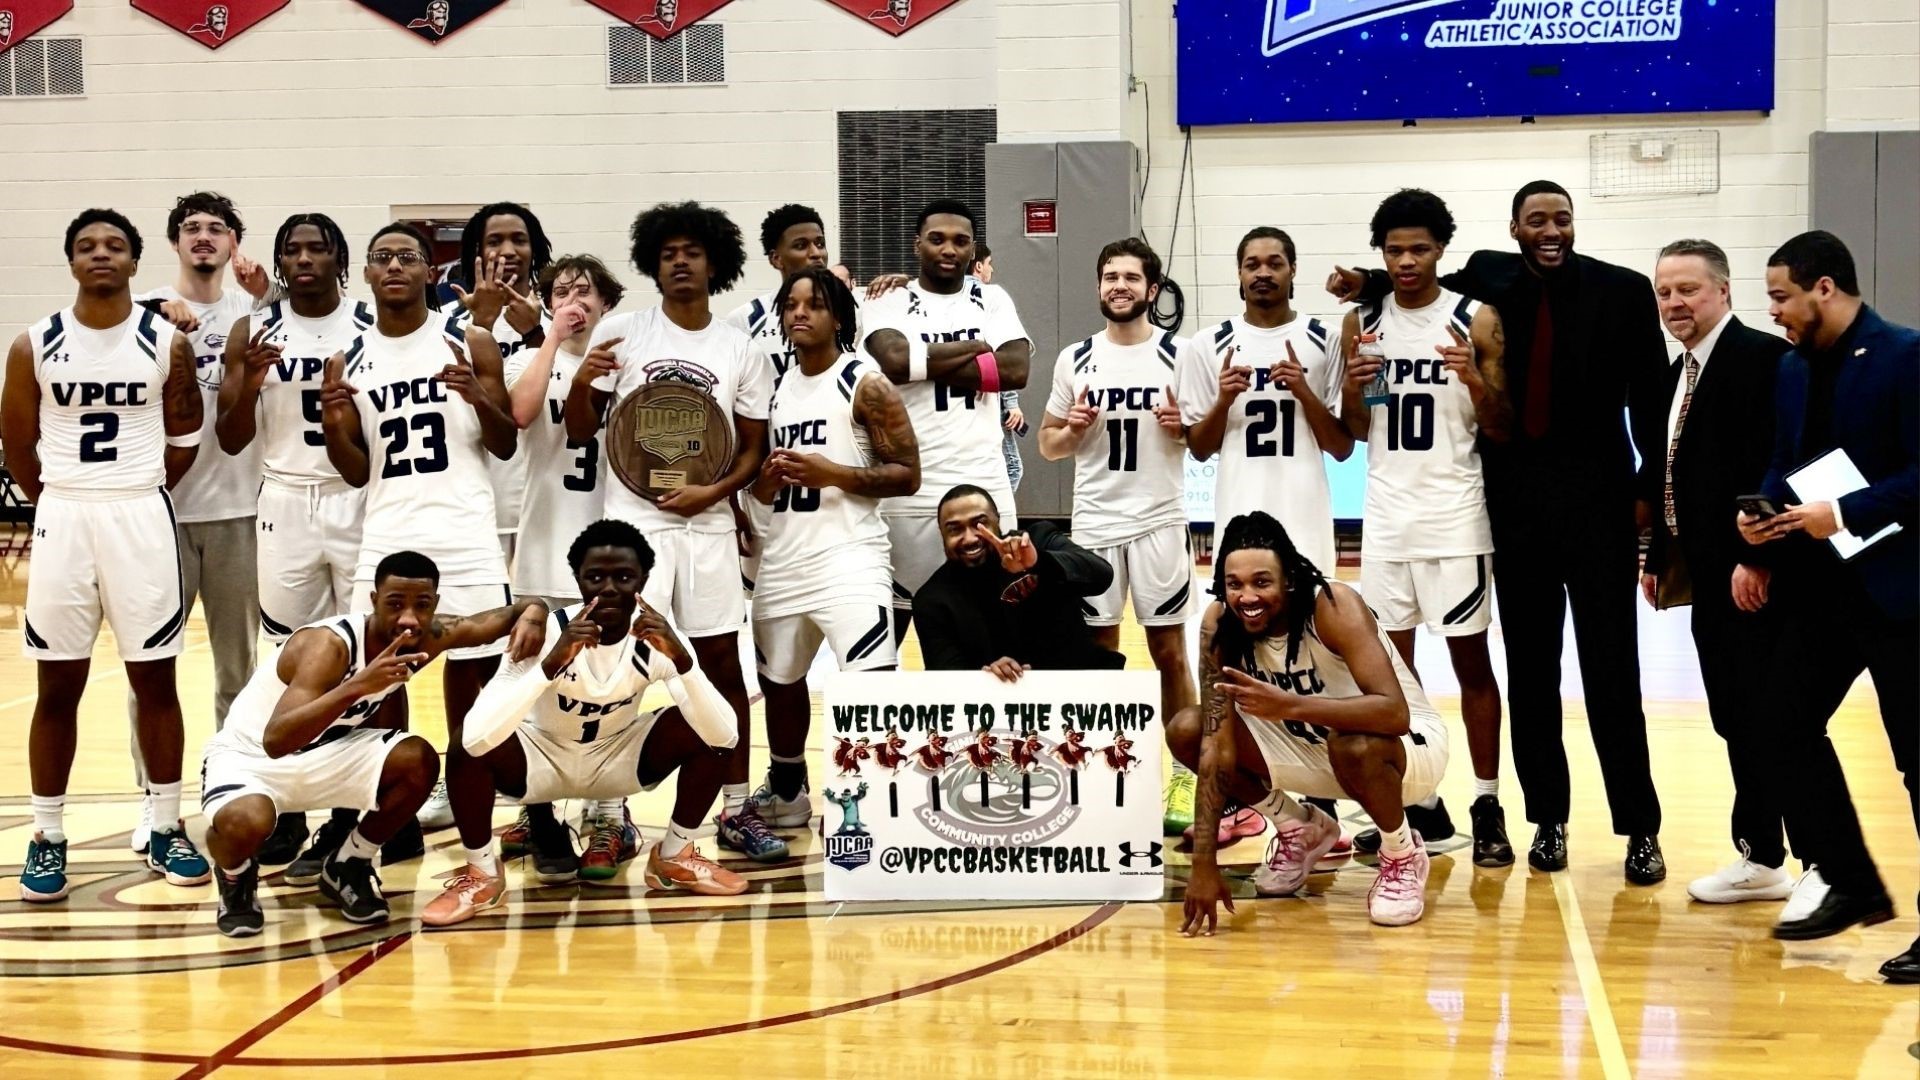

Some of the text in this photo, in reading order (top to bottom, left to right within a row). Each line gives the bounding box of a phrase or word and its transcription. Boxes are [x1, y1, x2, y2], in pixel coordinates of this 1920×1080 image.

[1496, 0, 1676, 20] JUNIOR COLLEGE
[1430, 18, 1676, 43] ATHLETIC ASSOCIATION
[51, 382, 147, 406] VPCC
[368, 377, 447, 413] VPCC
[1088, 387, 1159, 411] VPCC
[774, 420, 827, 448] VPCC
[1245, 399, 1295, 457] 21
[1387, 393, 1434, 451] 10
[80, 412, 119, 462] 2
[380, 412, 448, 479] 23
[1107, 418, 1138, 471] 11
[563, 437, 599, 492] 3
[573, 719, 600, 744] 1
[832, 703, 1155, 732] WELCOME TO THE SWAMP
[921, 806, 1076, 846] COMMUNITY COLLEGE
[825, 837, 873, 858] NJCAA
[880, 846, 1110, 874] @VPCCBASKETBALL
